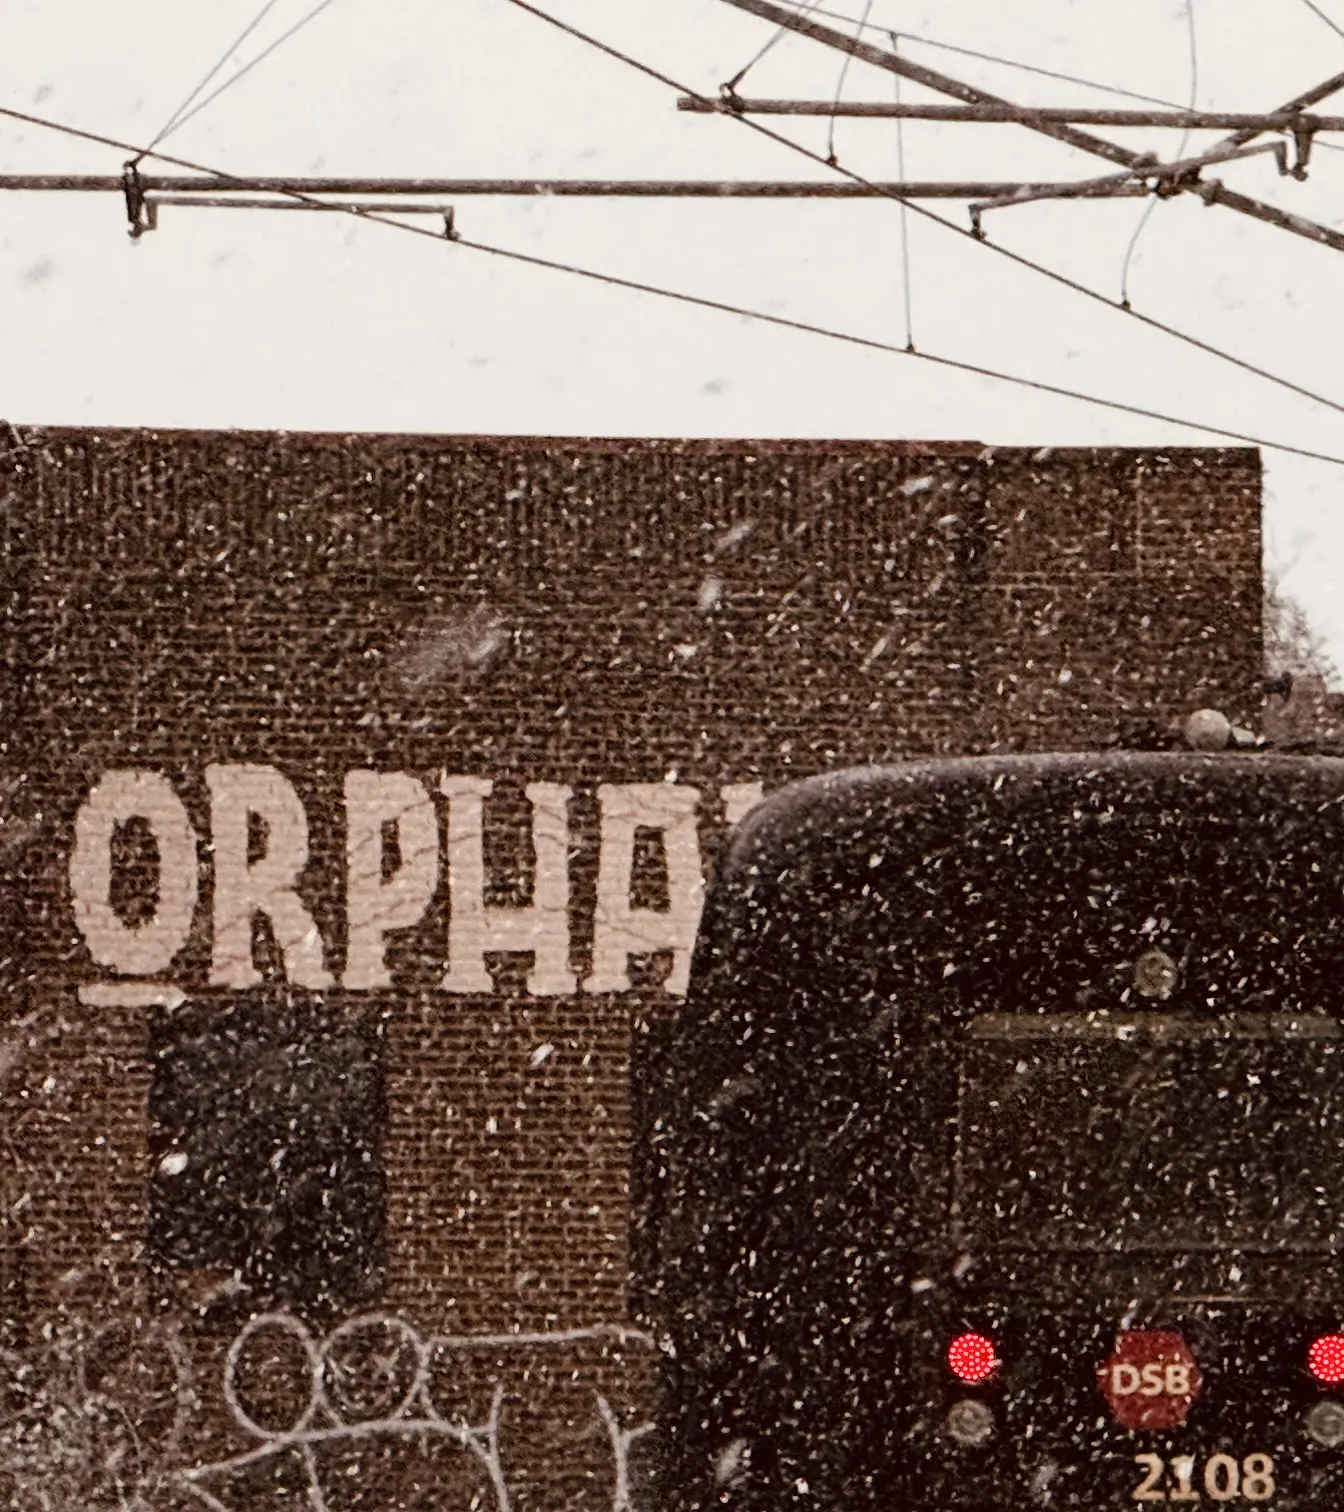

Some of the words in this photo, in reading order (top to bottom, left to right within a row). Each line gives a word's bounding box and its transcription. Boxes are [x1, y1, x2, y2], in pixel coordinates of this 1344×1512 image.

[69, 763, 764, 996] ORPHA
[1112, 1363, 1190, 1396] DSB
[1131, 1453, 1275, 1501] 2108
